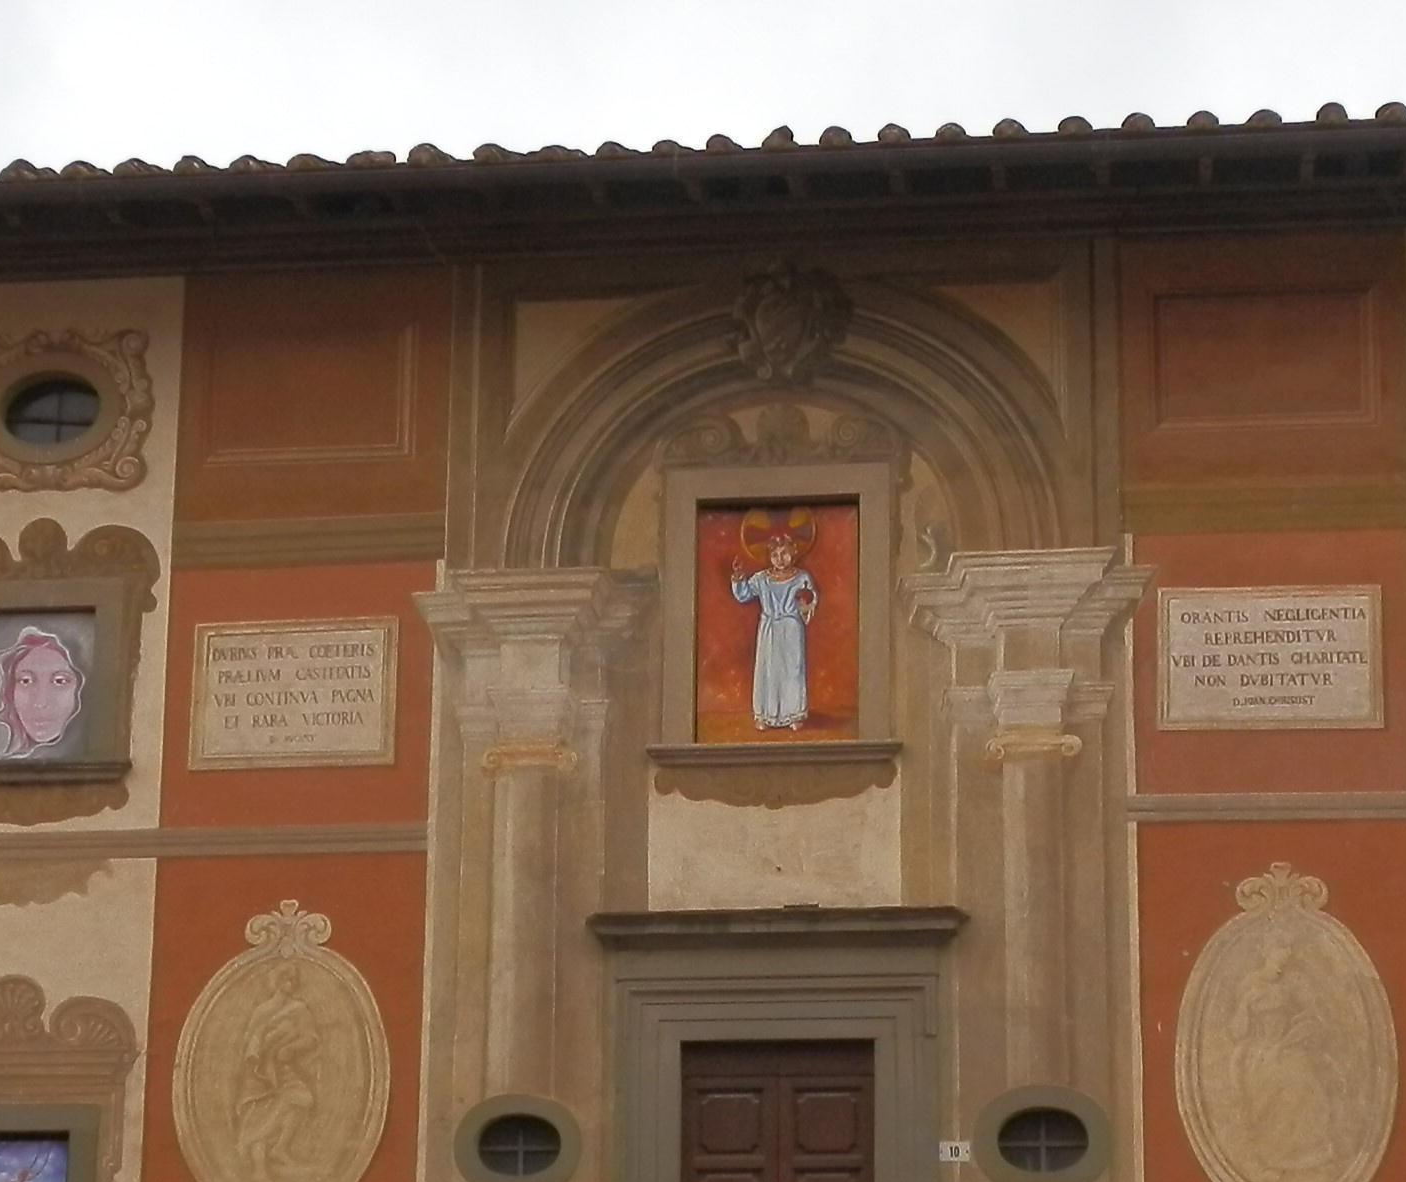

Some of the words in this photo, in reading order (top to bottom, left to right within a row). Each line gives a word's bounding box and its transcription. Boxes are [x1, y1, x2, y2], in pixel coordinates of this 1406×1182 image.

[1180, 608, 1250, 625] ORANTIS
[1263, 606, 1369, 624] NEGLIGENTIA
[1204, 628, 1338, 646] REPREHENDITVR
[211, 646, 258, 663] DVRIVS
[1170, 654, 1195, 669] VBI
[1201, 653, 1222, 668] DE
[1227, 651, 1281, 668] DANTIS
[1290, 649, 1369, 667] CHARITATE
[295, 665, 372, 682] CASTITATIS
[1194, 674, 1227, 688] NON
[1239, 671, 1335, 688] DVBITATVR
[212, 693, 236, 709] VBI
[245, 690, 319, 708] CONTINVA
[331, 688, 375, 705] PVGNA
[223, 714, 240, 730] ET
[251, 713, 289, 729] RARA
[302, 711, 365, 727] VICTORIA
[948, 1145, 960, 1158] 10
